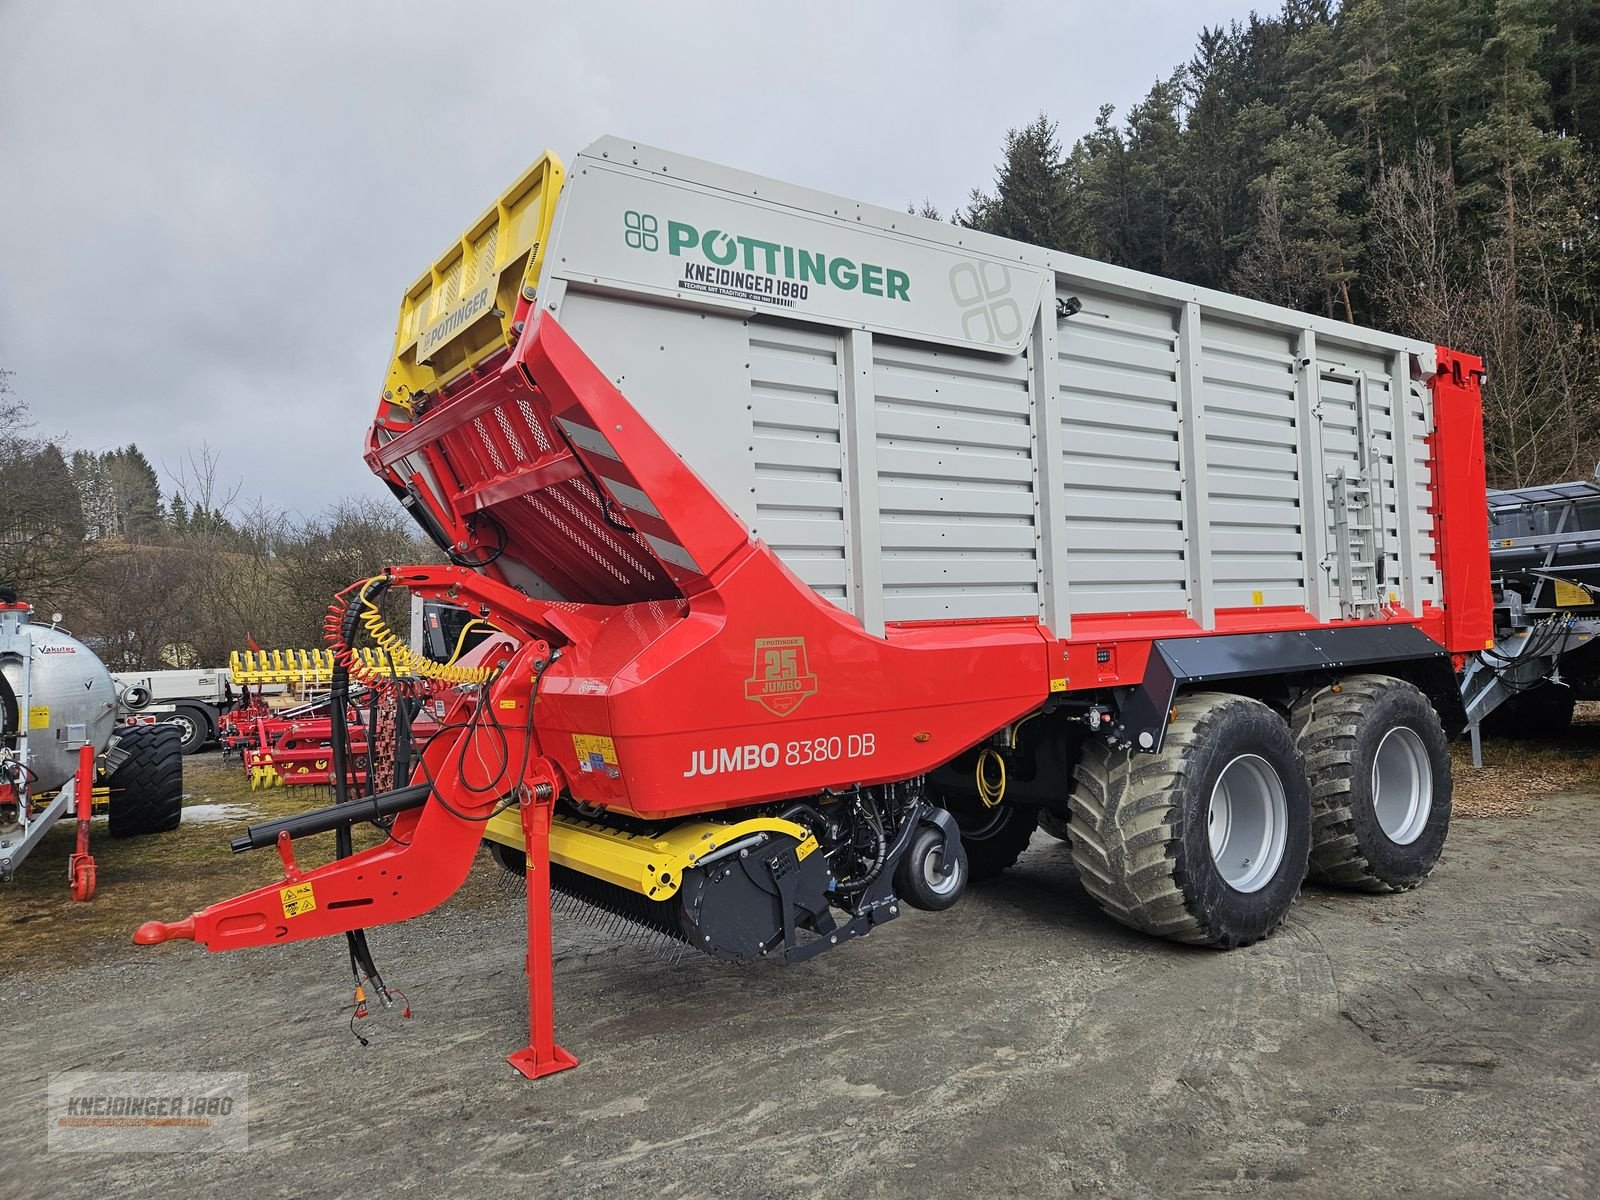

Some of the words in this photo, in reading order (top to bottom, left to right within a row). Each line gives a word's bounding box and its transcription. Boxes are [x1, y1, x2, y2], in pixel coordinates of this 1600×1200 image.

[684, 281, 708, 292] TECHNIK
[719, 288, 748, 299] TRADITION
[685, 262, 773, 294] KNEIDINGER
[776, 280, 808, 300] 1880
[765, 649, 797, 680] 25
[762, 680, 802, 693] JUMBO
[683, 742, 780, 777] JUMBO
[785, 736, 842, 766] 8380
[848, 733, 876, 758] DB
